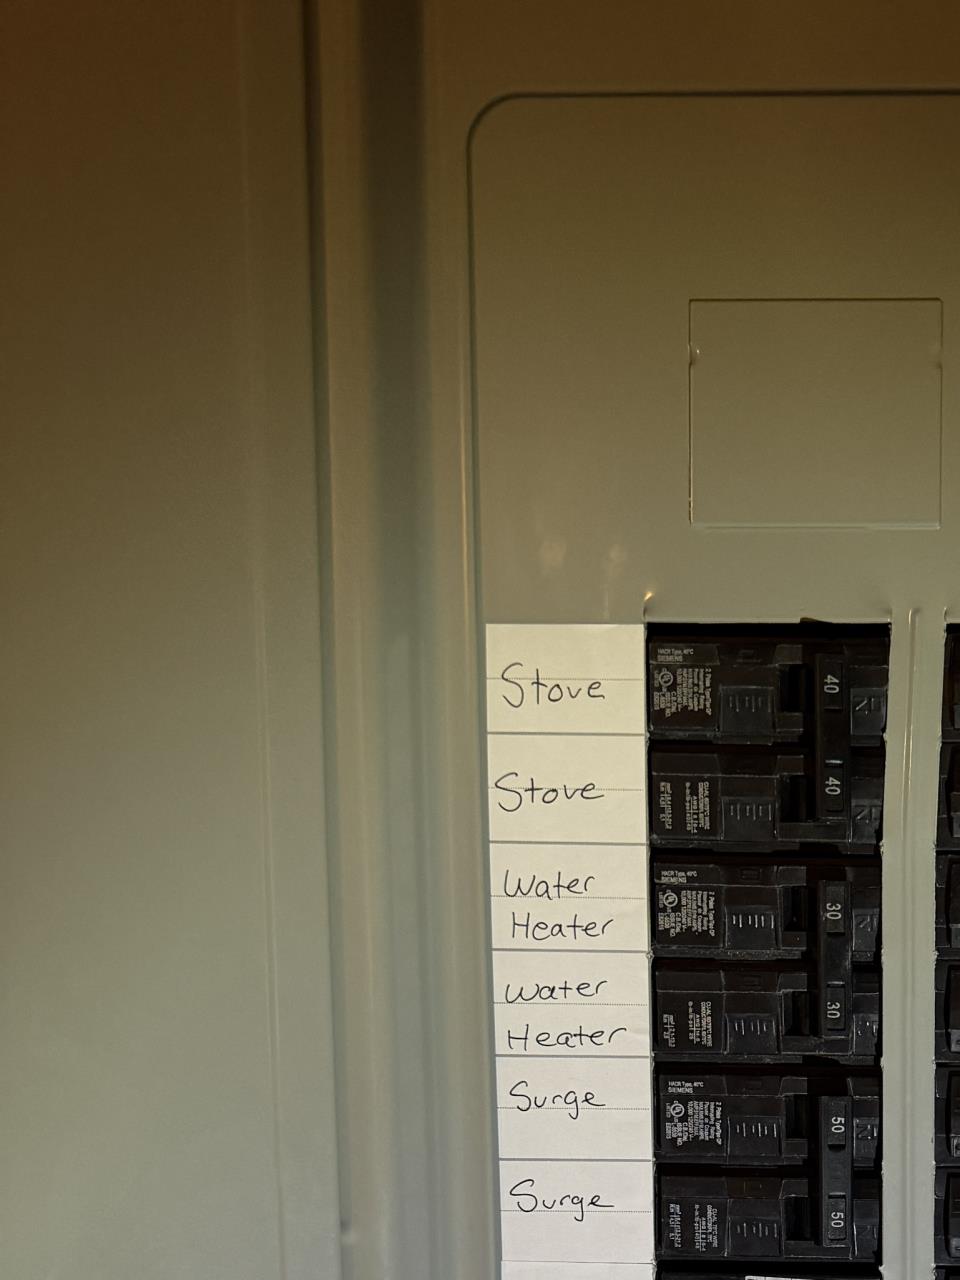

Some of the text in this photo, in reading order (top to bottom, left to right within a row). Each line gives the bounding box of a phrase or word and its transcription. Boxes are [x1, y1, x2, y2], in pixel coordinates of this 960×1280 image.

[501, 663, 605, 708] Stove
[824, 675, 839, 694] 40
[495, 772, 604, 812] Stove
[825, 777, 840, 795] 40
[504, 870, 595, 900] Water
[826, 903, 842, 920] 30
[511, 912, 613, 940] Heater
[827, 1001, 839, 1019] 30
[508, 1024, 626, 1050] Heater
[509, 1081, 605, 1122] Surge
[831, 1117, 844, 1134] 50
[509, 1179, 614, 1222] Surge
[831, 1212, 843, 1228] 50
